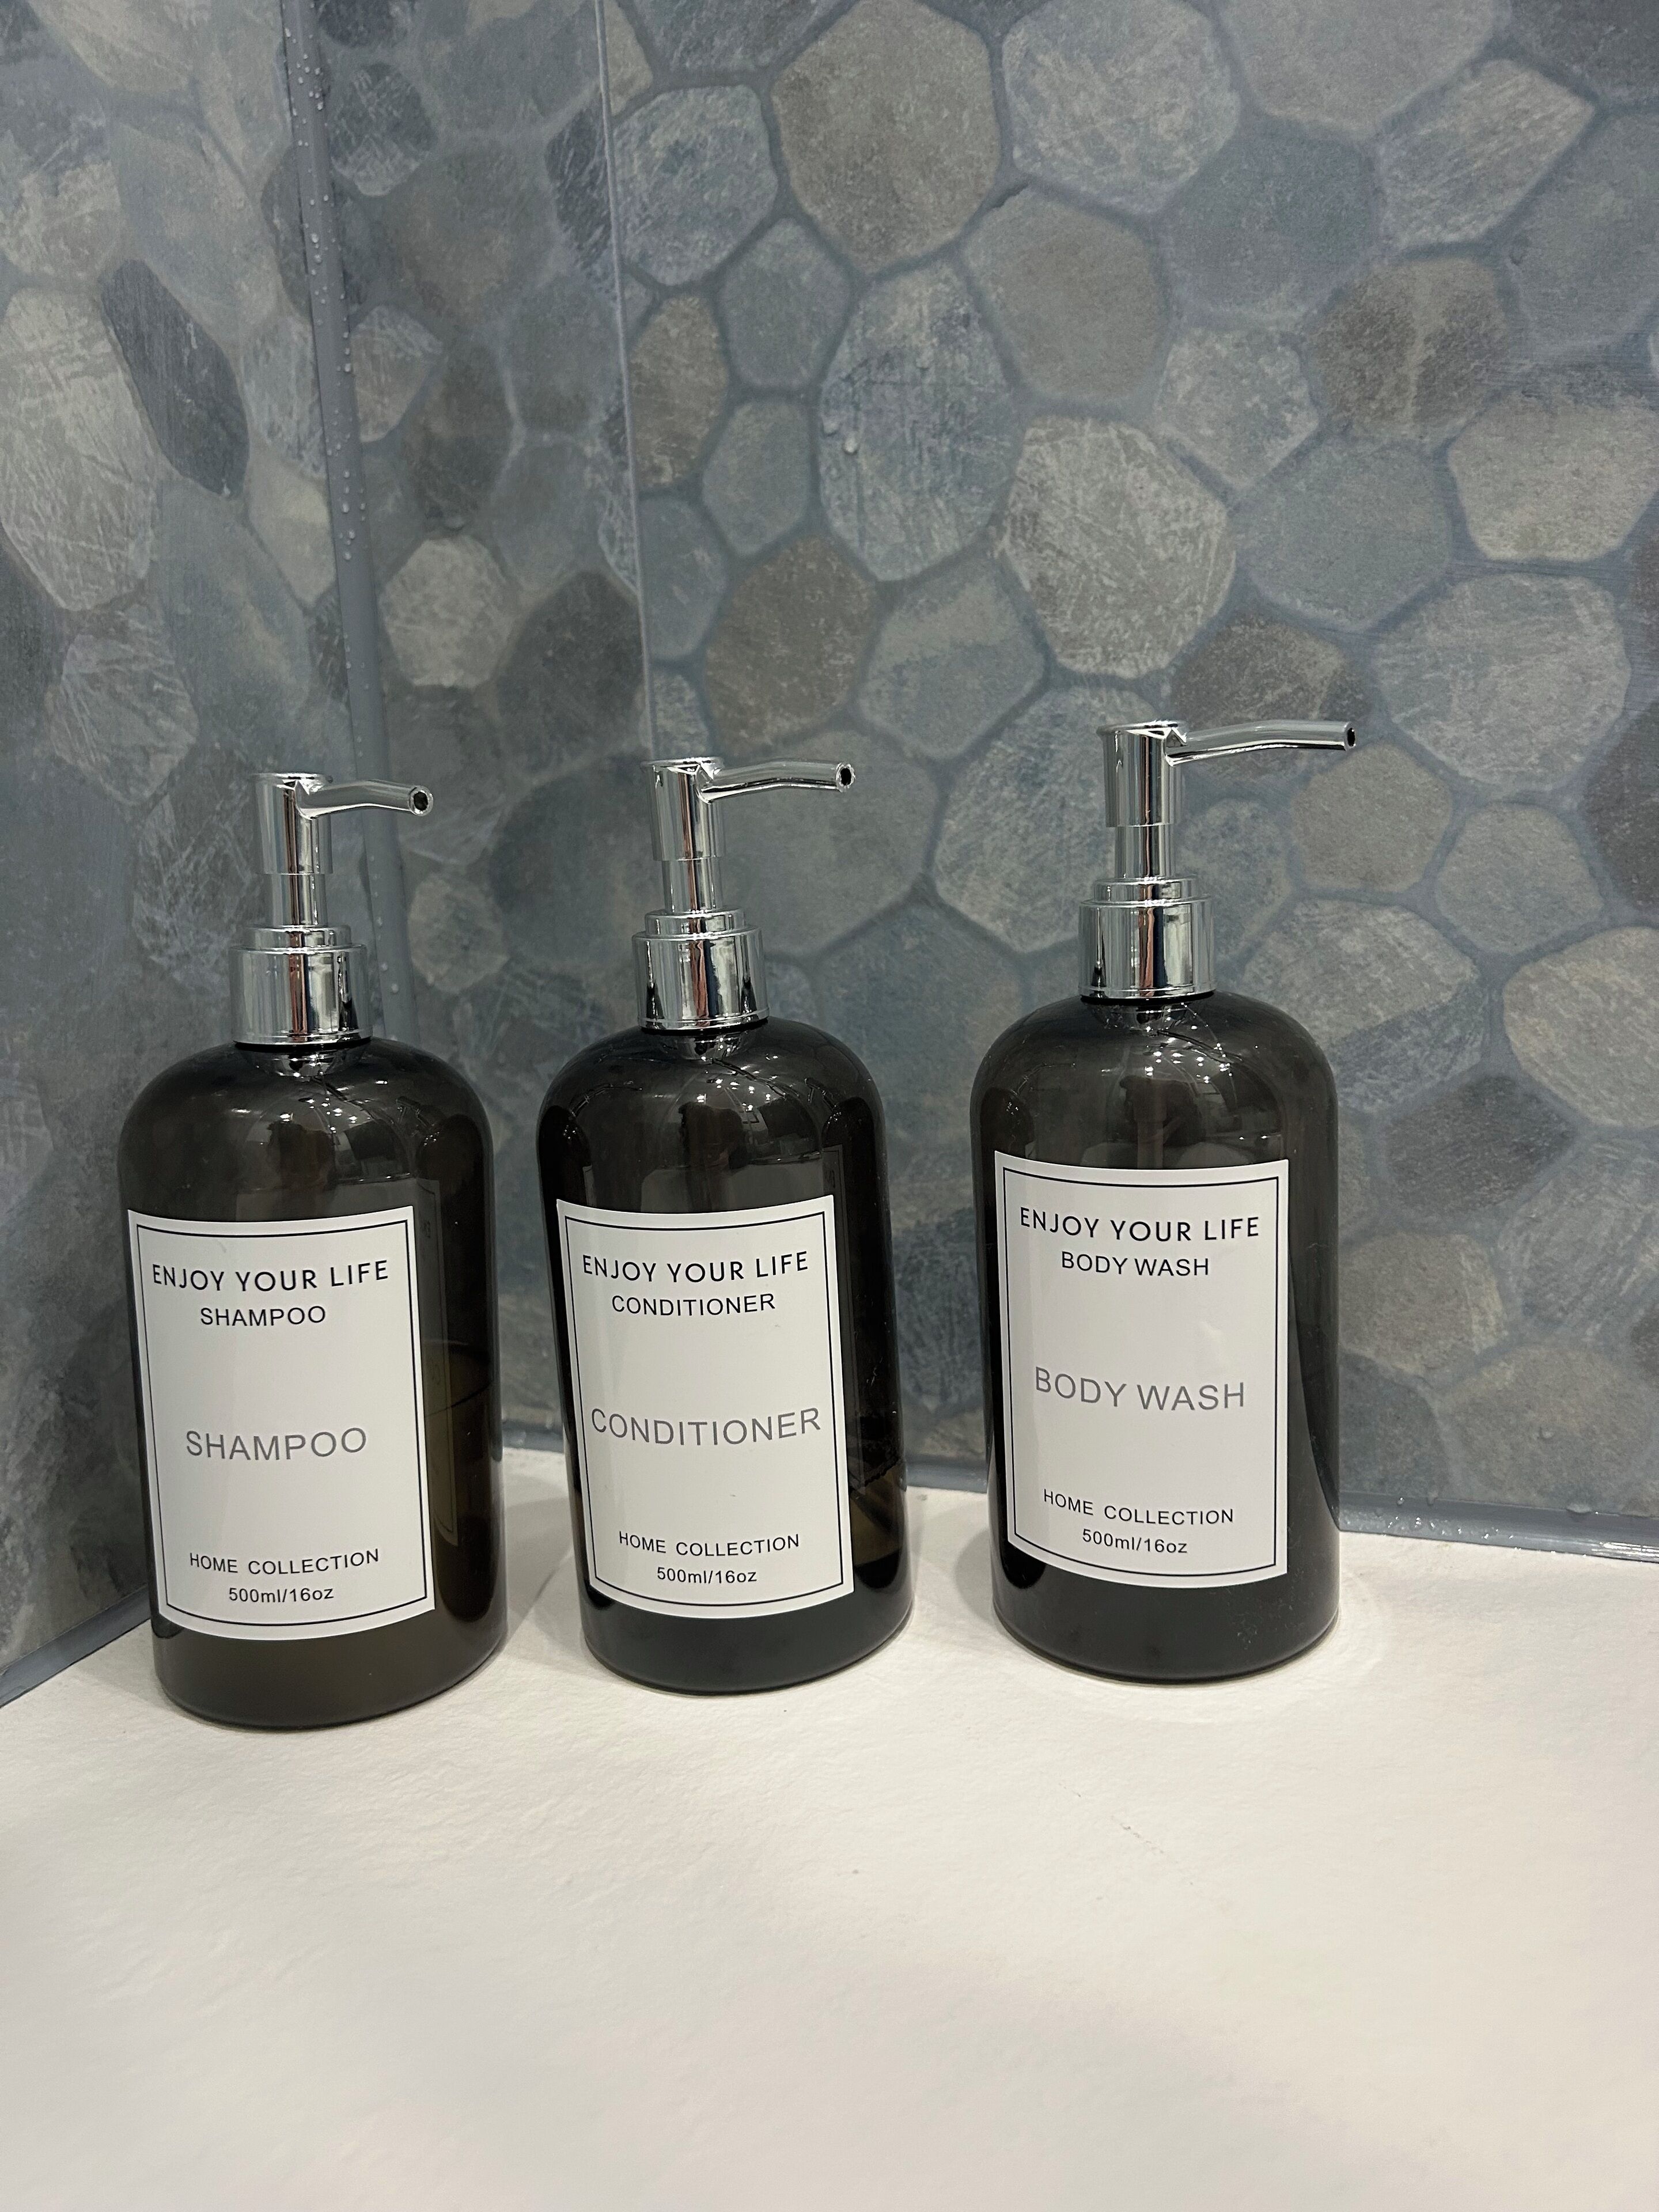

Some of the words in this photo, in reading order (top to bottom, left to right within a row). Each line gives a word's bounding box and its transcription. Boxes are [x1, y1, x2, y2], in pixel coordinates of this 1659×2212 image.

[1020, 1206, 1100, 1239] ENJOY
[1109, 1219, 1192, 1243] YOUR
[1203, 1215, 1260, 1241] LIFE
[151, 1263, 225, 1292] ENJOY
[234, 1268, 319, 1293] YOUR
[329, 1259, 389, 1287] LIFE
[582, 1253, 657, 1283] ENJOY
[665, 1260, 745, 1283] YOUR
[755, 1250, 809, 1279] LIFE
[1061, 1250, 1129, 1275] BODY
[1133, 1257, 1209, 1277] WASH
[200, 1305, 327, 1327] SHAMPOO
[611, 1293, 777, 1317] CONDITIONER
[1035, 1365, 1128, 1408] BODY
[1135, 1381, 1245, 1411] WASH
[590, 1407, 821, 1446] CONDITIONER
[185, 1427, 367, 1461] SHAMPOO
[1043, 1487, 1094, 1517] HOME
[1103, 1505, 1234, 1526] COLLECTION
[618, 1530, 667, 1554] HOME
[675, 1533, 800, 1558] COLLECTION
[1082, 1527, 1188, 1554] 500ml/16oz
[189, 1552, 239, 1574] HOME
[247, 1547, 380, 1575] COLLECTION
[656, 1566, 758, 1585] 500ml/16oz
[228, 1586, 335, 1604] 500ml/16oz
